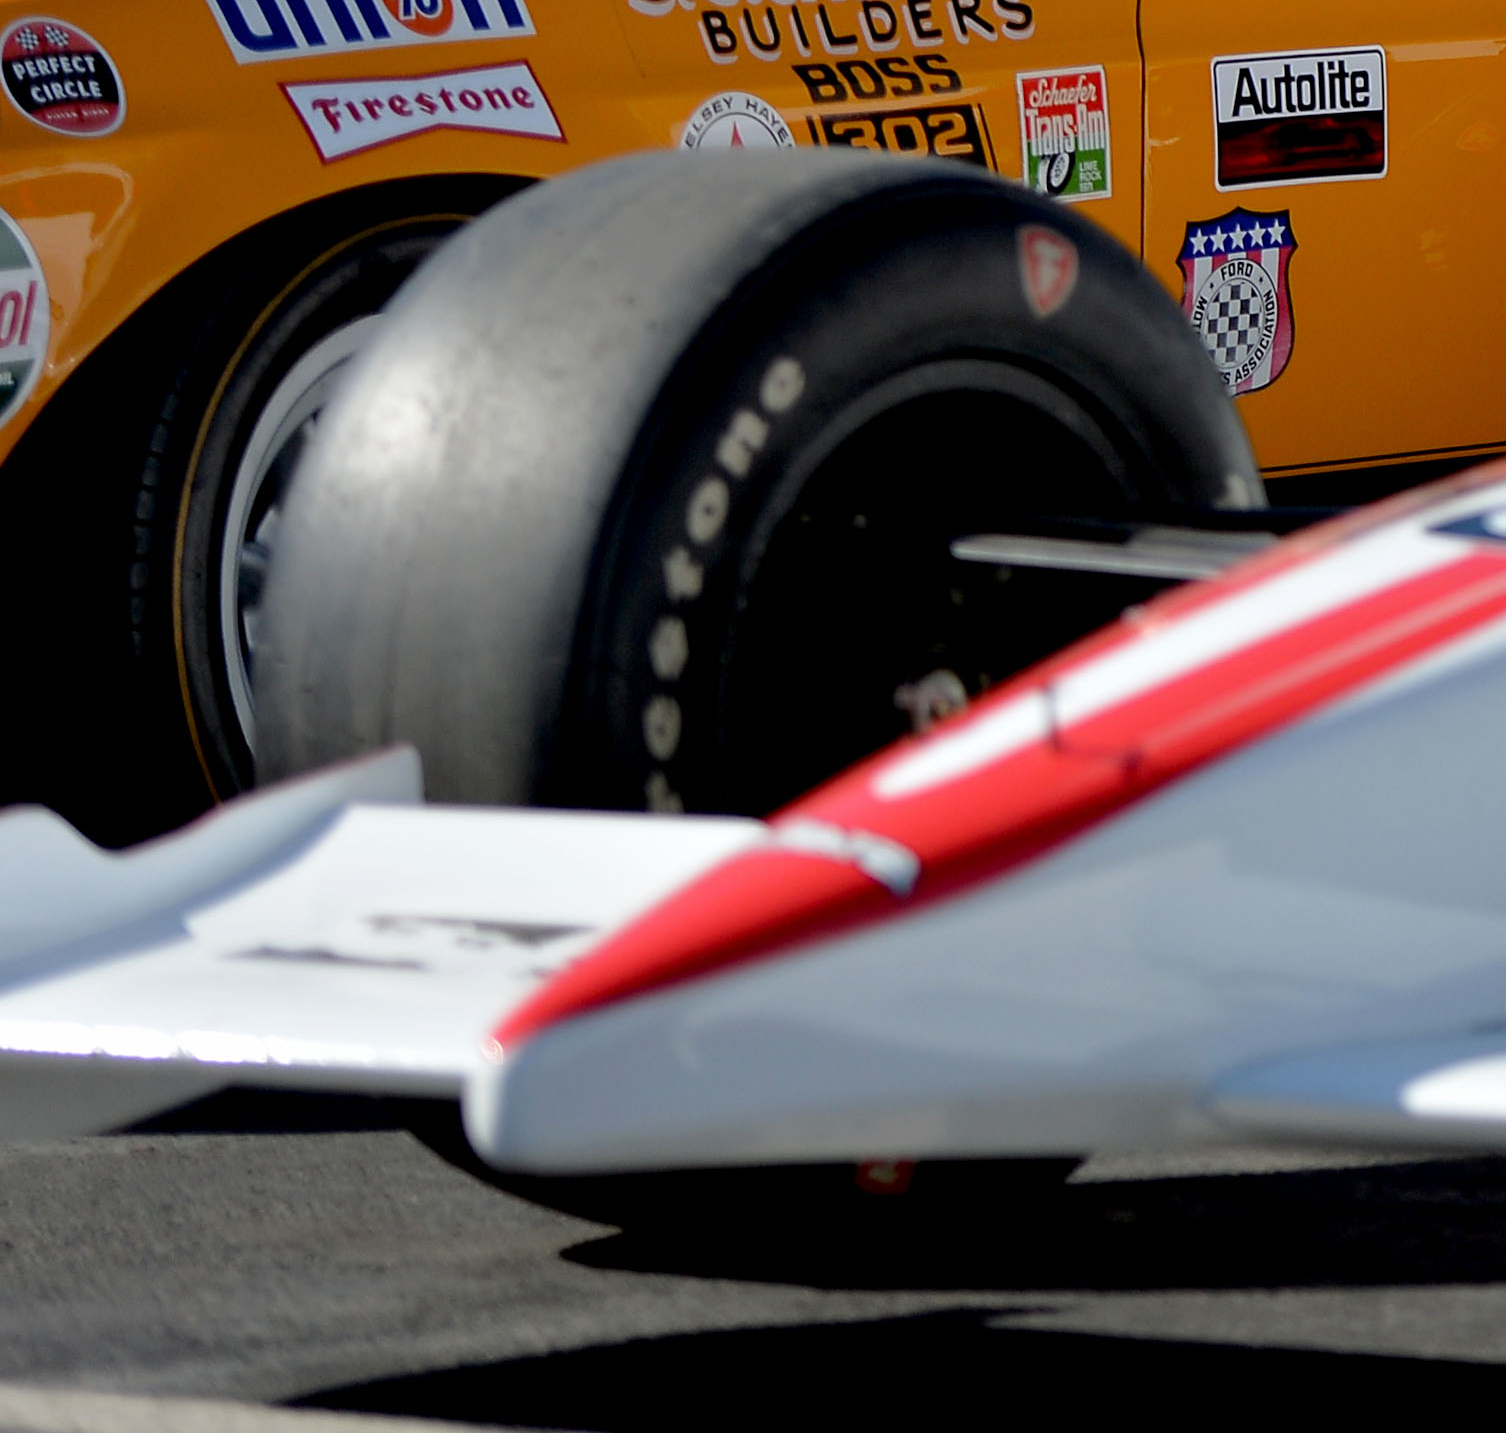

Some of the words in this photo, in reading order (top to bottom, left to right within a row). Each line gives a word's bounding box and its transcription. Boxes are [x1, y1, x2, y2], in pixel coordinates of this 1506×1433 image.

[11, 55, 96, 81] PERFECT
[30, 80, 103, 105] CIRCLE
[791, 53, 963, 104] BOSS
[1029, 74, 1098, 108] Schaefer
[1231, 61, 1371, 118] Autolite
[312, 76, 537, 136] Firestone
[684, 96, 735, 149] ELSEY
[832, 112, 974, 156] 302
[1220, 261, 1255, 281] FORD
[1234, 289, 1277, 384] ASSOCIATION
[643, 357, 806, 814] restone
